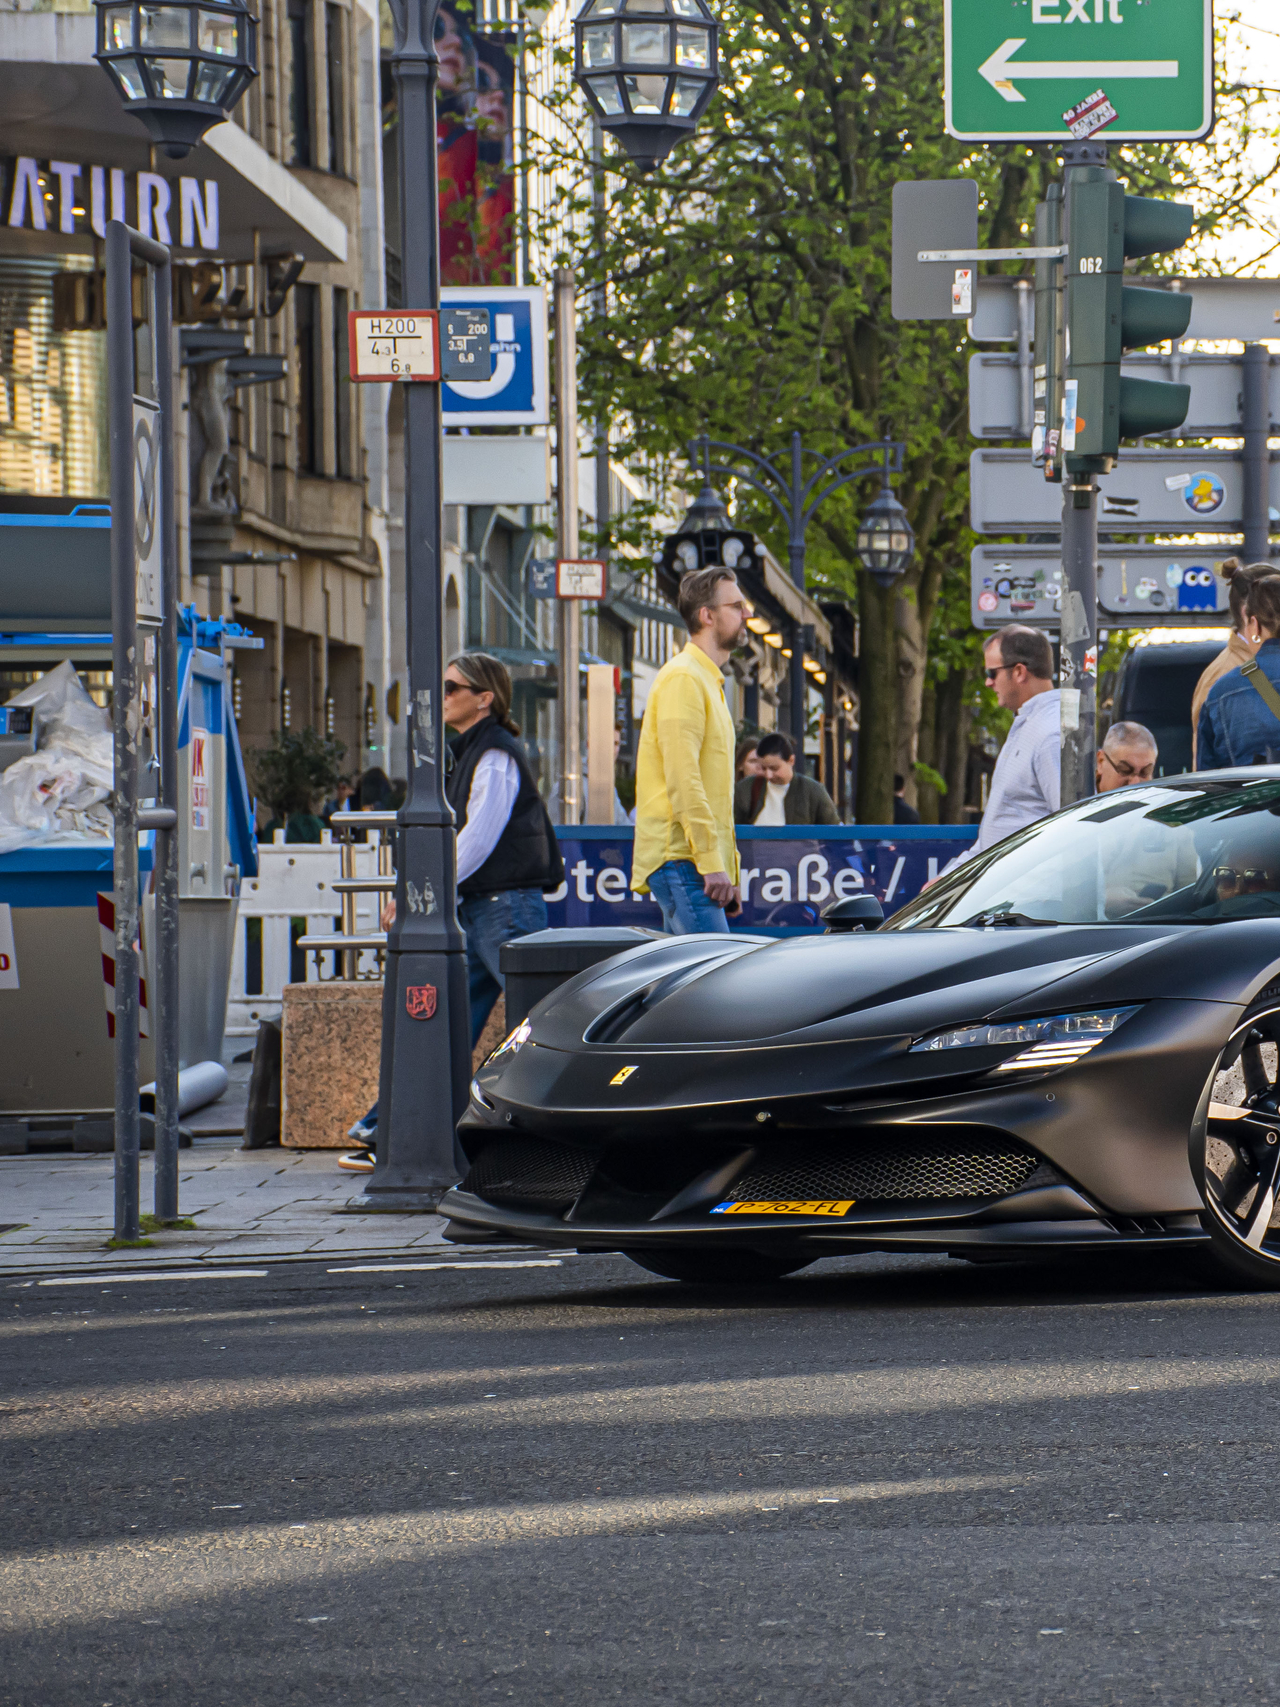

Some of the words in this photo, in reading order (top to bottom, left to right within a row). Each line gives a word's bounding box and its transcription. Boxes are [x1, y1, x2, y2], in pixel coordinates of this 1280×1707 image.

[1032, 0, 1124, 24] Exit
[0, 156, 219, 250] ATURN
[1080, 256, 1103, 274] 062
[370, 319, 416, 334] H200
[467, 323, 488, 335] 200
